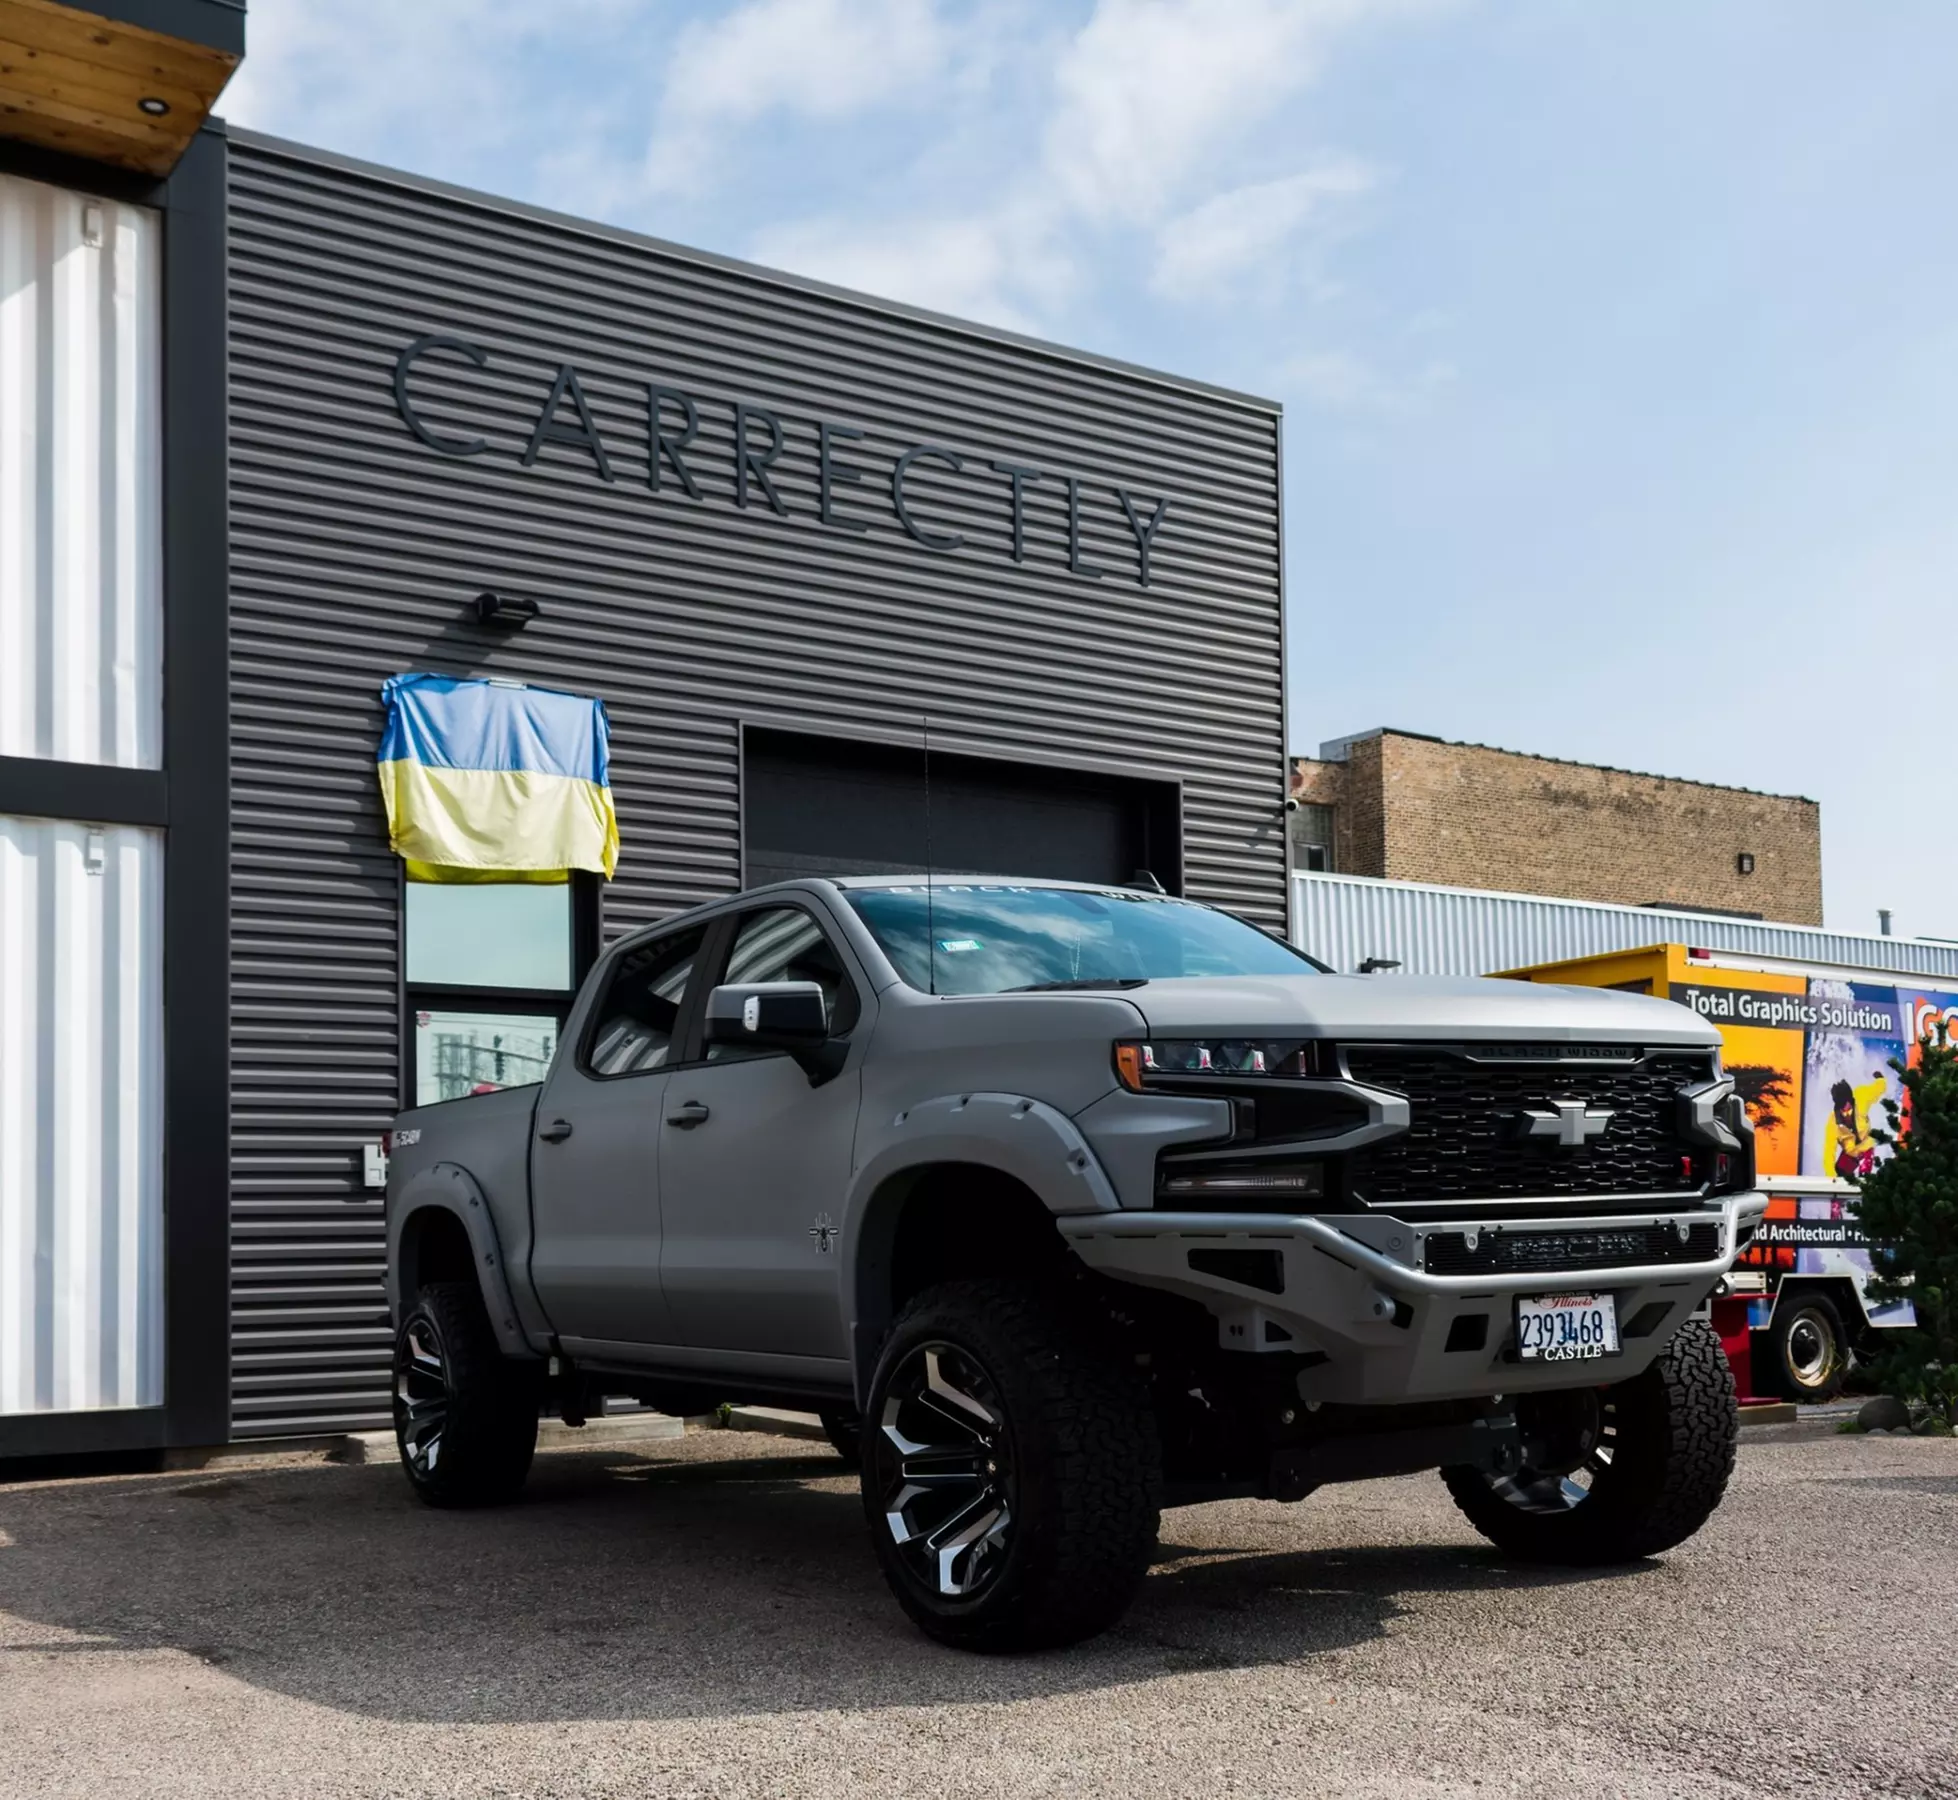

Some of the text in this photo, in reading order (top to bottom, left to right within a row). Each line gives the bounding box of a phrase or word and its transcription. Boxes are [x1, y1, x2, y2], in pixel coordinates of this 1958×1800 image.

[394, 334, 1170, 588] CARRECTLY
[1687, 990, 1892, 1031] Total Graphics Solution
[1751, 1223, 1767, 1240] nd
[1770, 1224, 1845, 1241] Architectural
[1539, 1297, 1593, 1309] Illinois
[1520, 1311, 1603, 1348] 2393468
[1544, 1345, 1602, 1360] CASTLE
